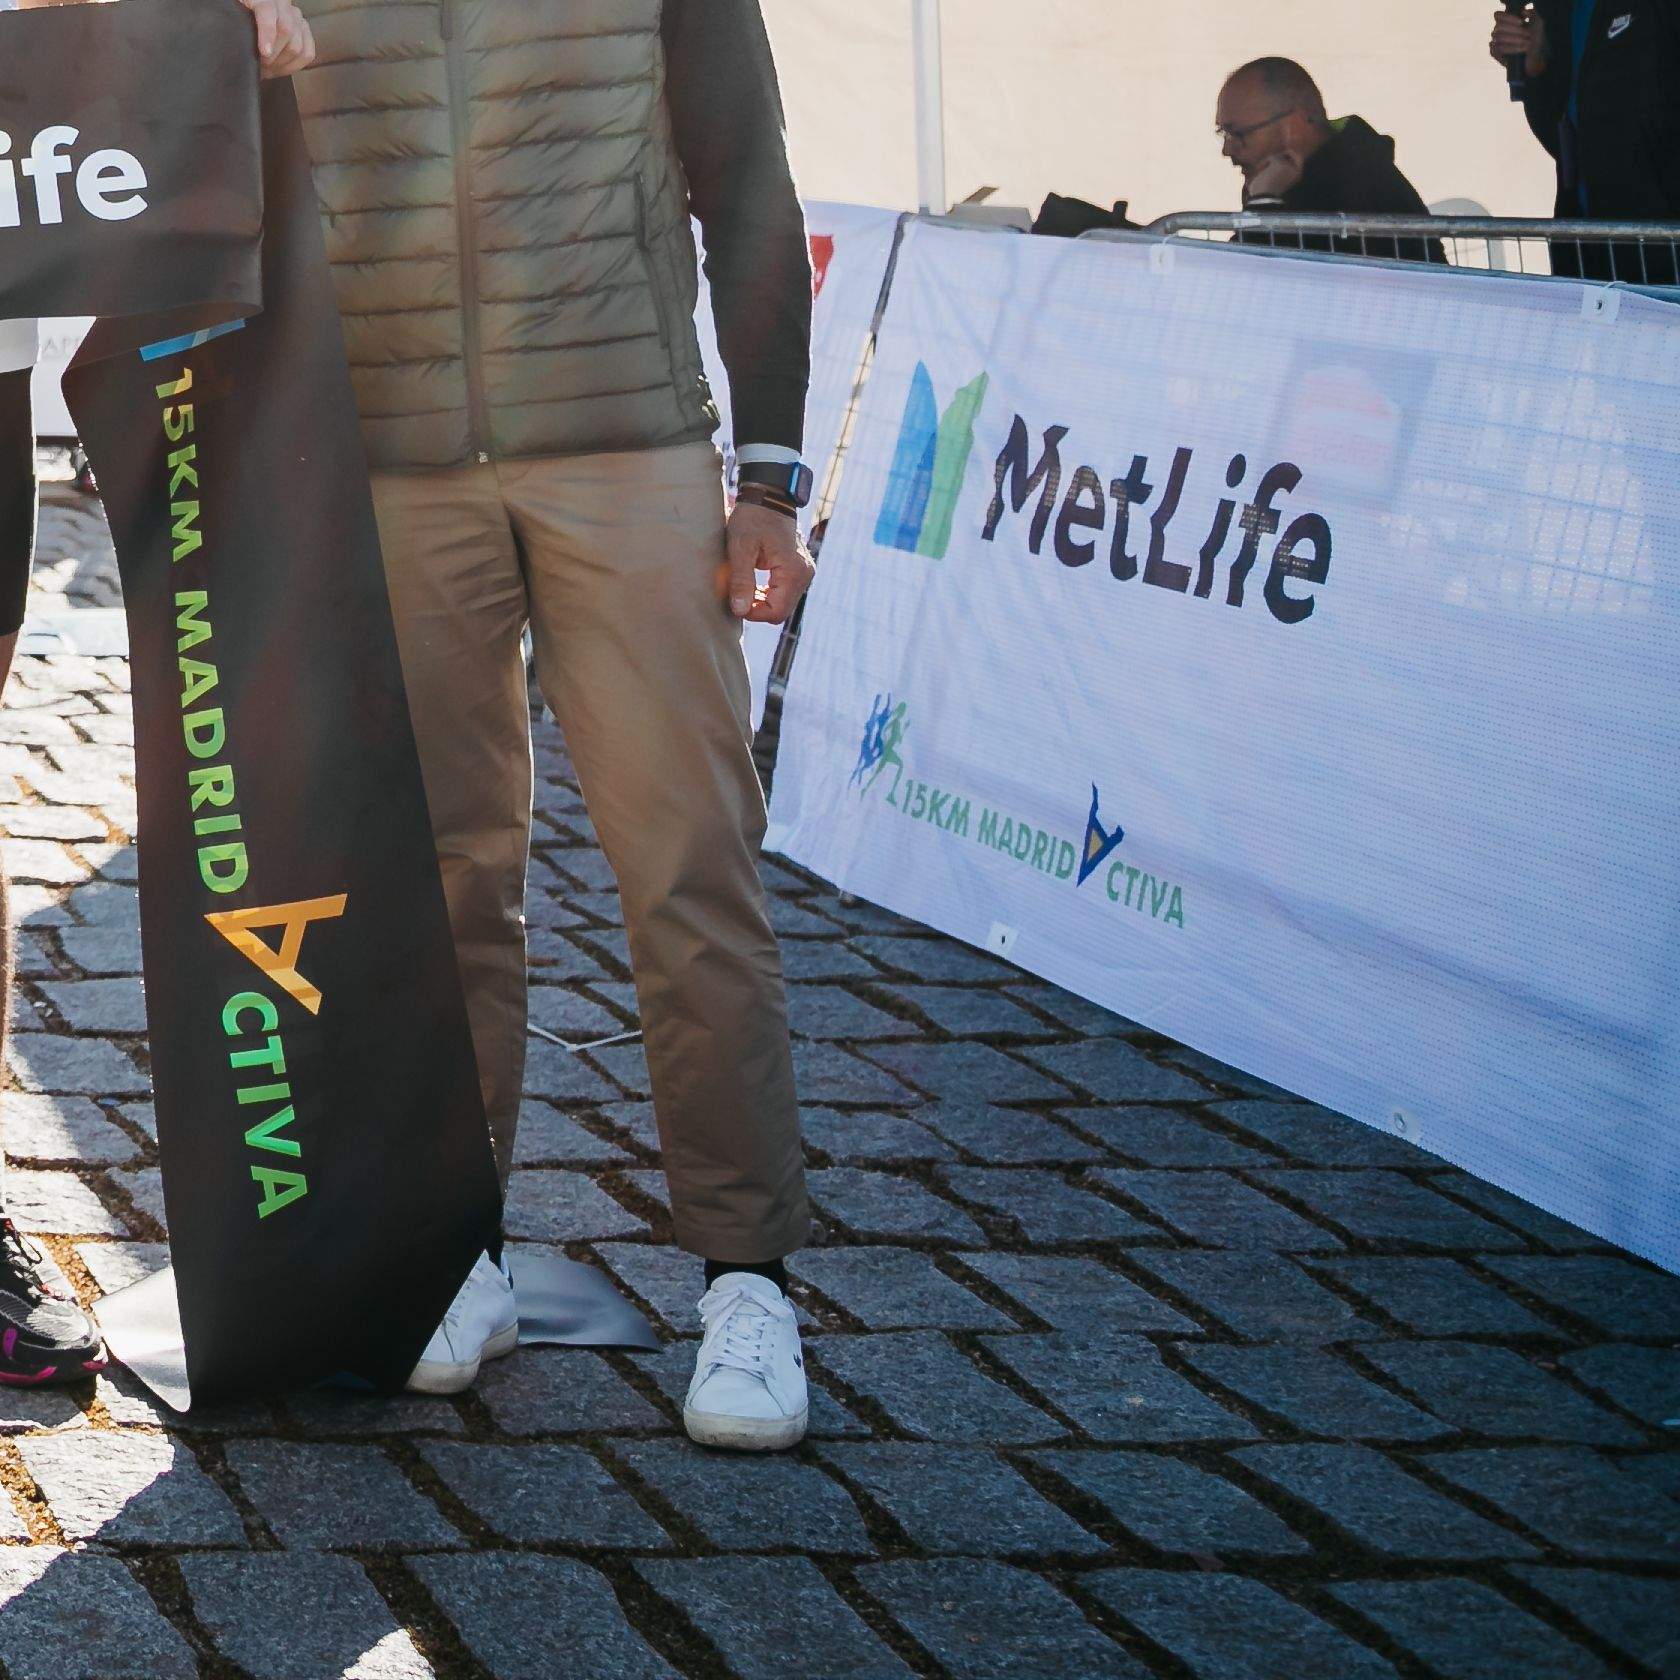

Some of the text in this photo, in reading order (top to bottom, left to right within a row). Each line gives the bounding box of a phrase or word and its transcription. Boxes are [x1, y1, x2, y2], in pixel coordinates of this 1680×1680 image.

[156, 367, 203, 562] 15KM
[982, 414, 1332, 624] MetLife
[174, 590, 249, 894] MADRID
[902, 779, 971, 837] 15KM
[978, 808, 1075, 880] MADRID
